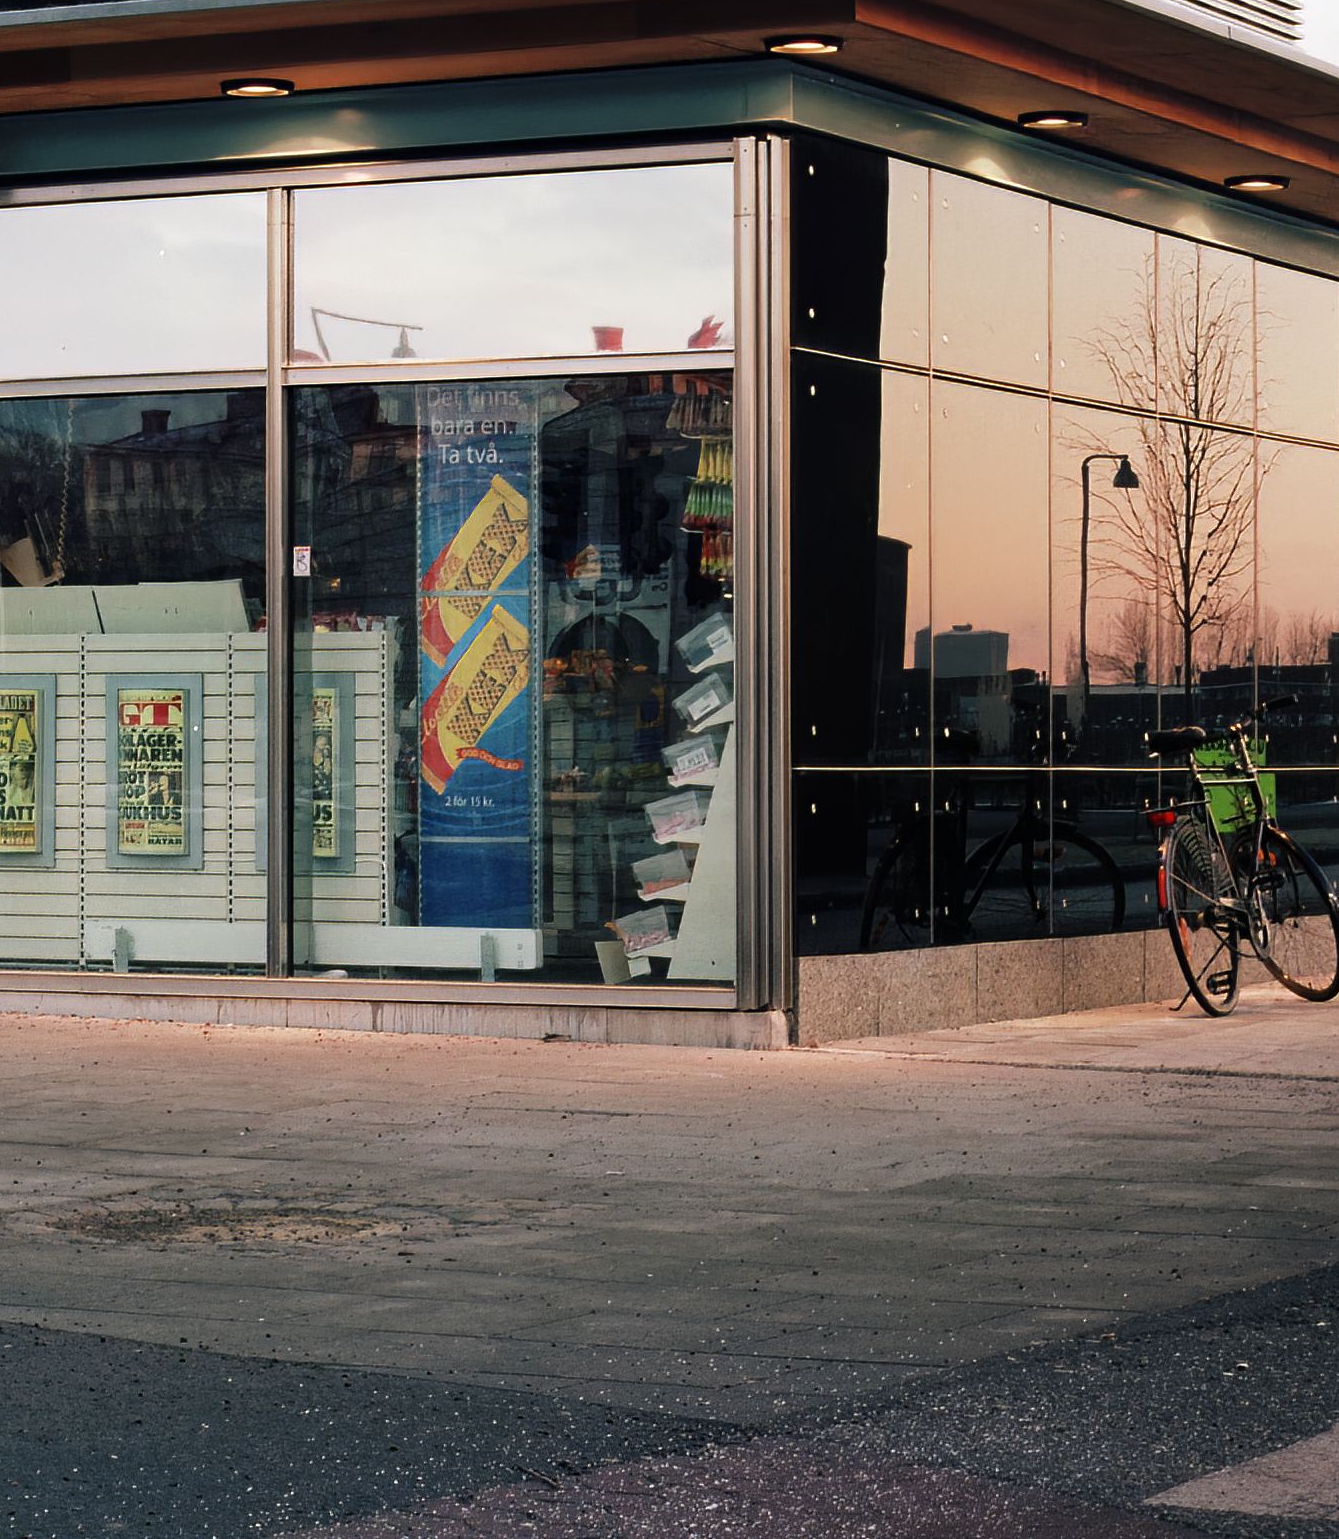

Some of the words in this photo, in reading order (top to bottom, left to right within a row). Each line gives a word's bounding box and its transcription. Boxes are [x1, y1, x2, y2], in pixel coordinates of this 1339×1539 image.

[427, 386, 462, 406] Det
[466, 385, 519, 406] finns
[431, 415, 475, 436] bara
[481, 419, 514, 435] en.
[438, 443, 460, 464] Ta
[466, 442, 504, 464] två.
[446, 632, 530, 746] KEX
[120, 702, 182, 727] GT
[444, 796, 453, 807] 2
[453, 796, 467, 807] för
[483, 795, 495, 807] kr.
